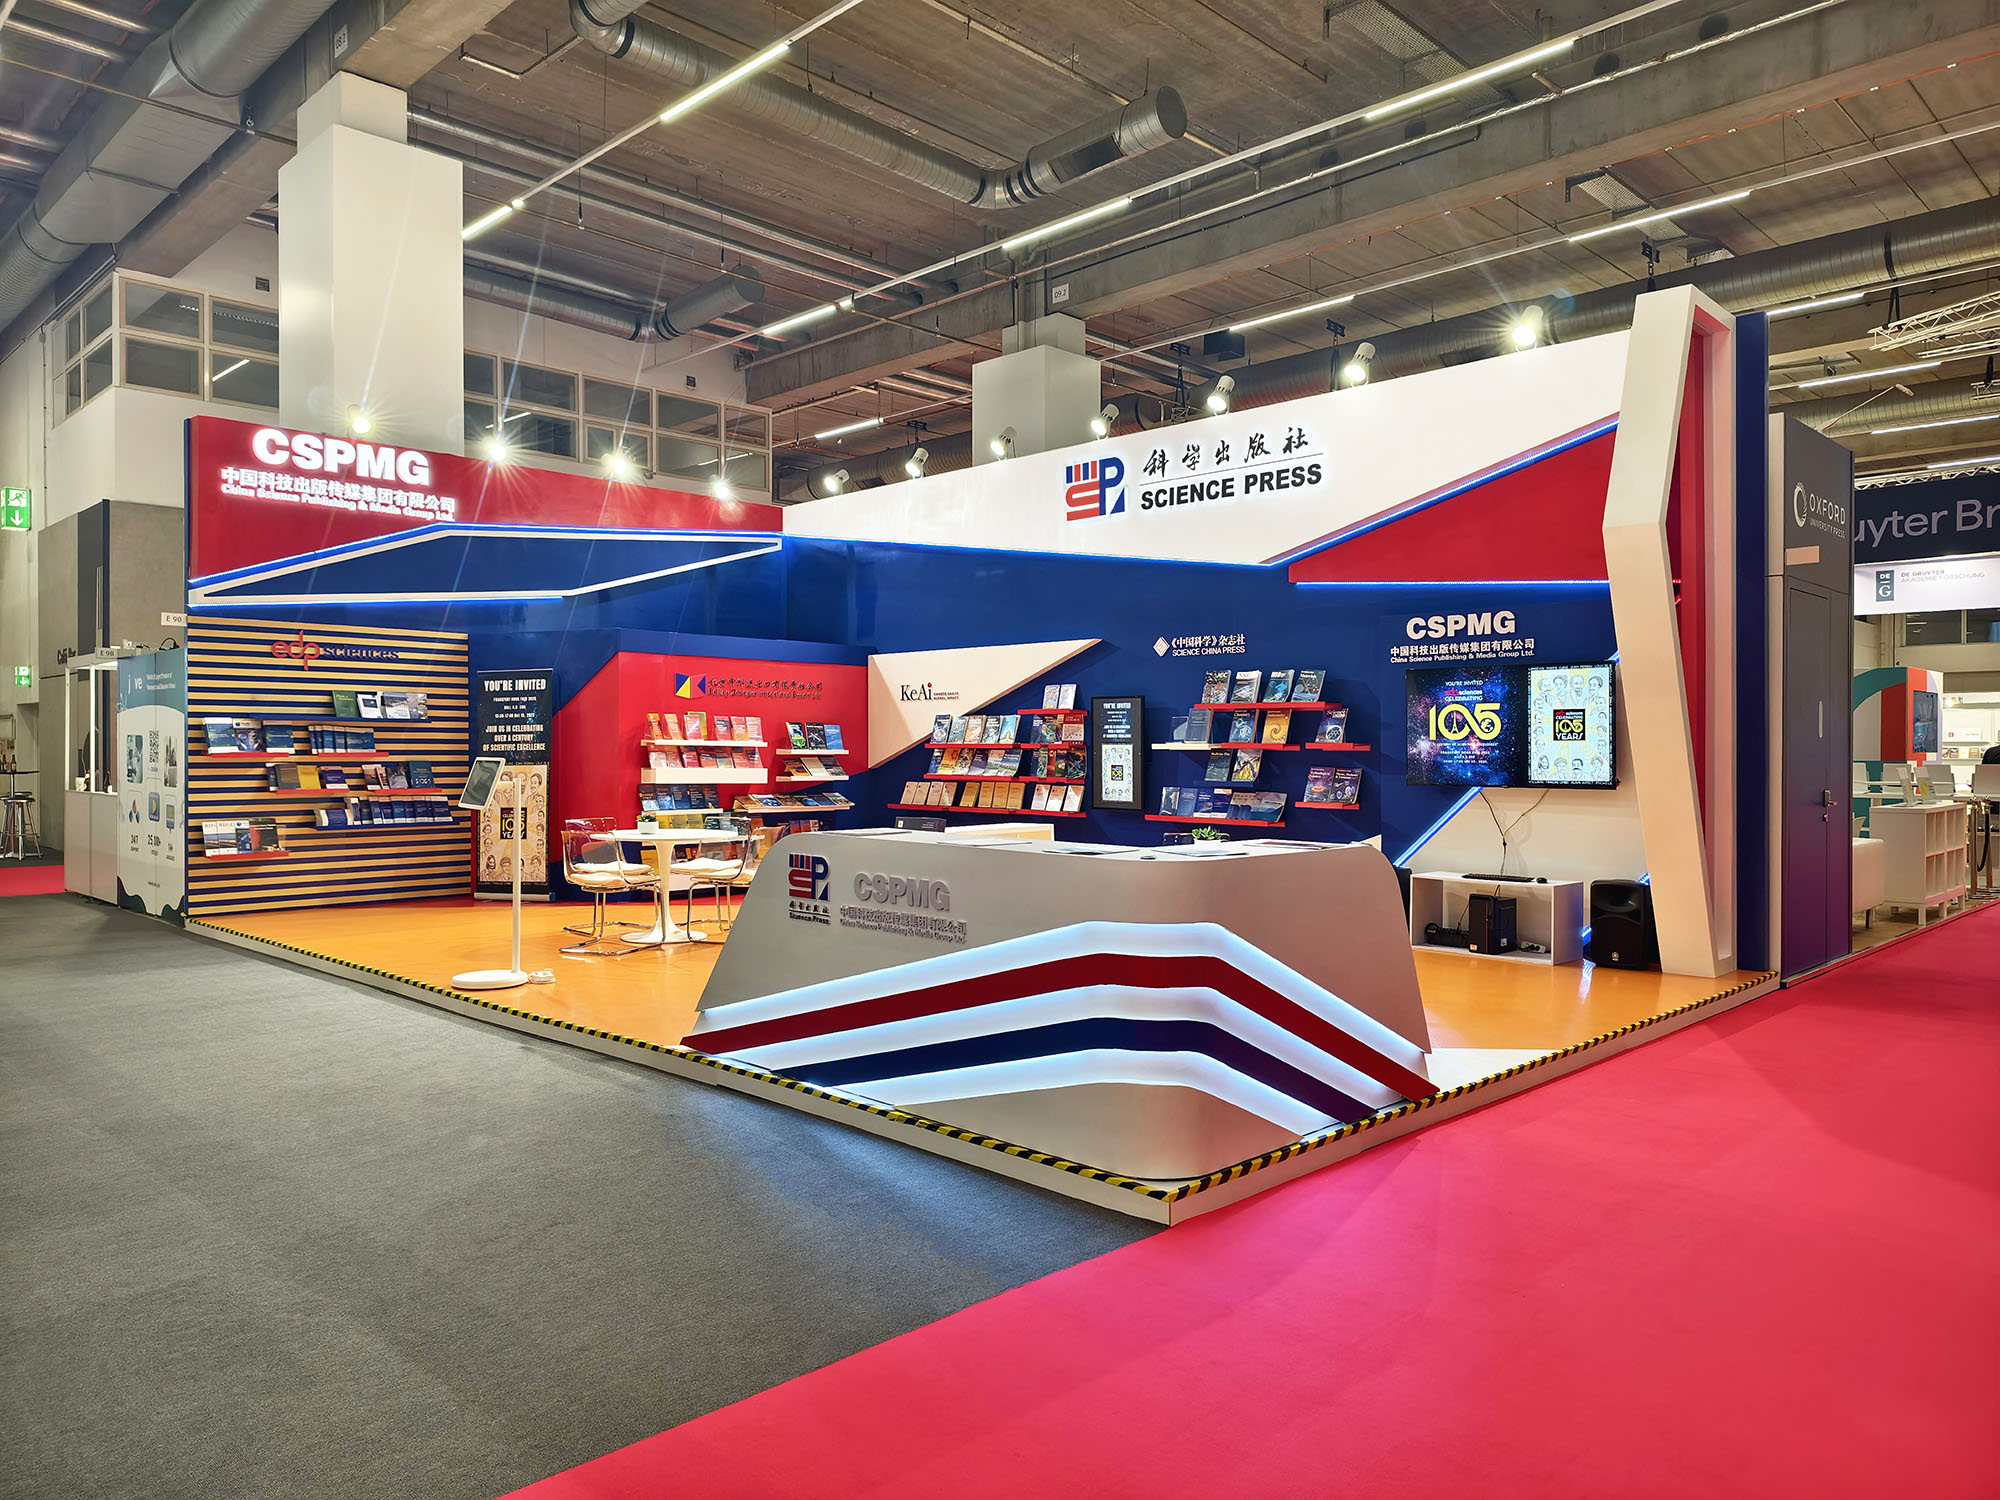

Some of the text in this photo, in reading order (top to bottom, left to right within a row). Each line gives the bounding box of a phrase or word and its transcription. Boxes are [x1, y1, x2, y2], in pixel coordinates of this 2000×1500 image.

[1054, 289, 1067, 298] 09.2
[252, 428, 431, 486] CSPMG
[1143, 426, 1308, 478] 科学出版社
[221, 467, 456, 513] 中国科技出版传媒集团有限公司
[1141, 463, 1322, 510] SCIENCE PRESS
[221, 483, 255, 497] China
[257, 487, 300, 503] Science
[301, 493, 356, 511] Publishing
[358, 501, 368, 511] &
[370, 502, 401, 515] Media
[403, 507, 434, 521] Group
[1810, 493, 1846, 525] OXFORD
[1879, 584, 1893, 598] G
[1406, 610, 1516, 640] CSPMG
[271, 629, 401, 671] edp sciences
[1172, 645, 1246, 656] SCIENCE CHINA PRESS
[1390, 638, 1535, 657] 中国科技出版传媒集团有限公司
[1409, 654, 1432, 663] Science
[1434, 653, 1467, 661] Publishing
[1468, 652, 1475, 660] &
[1476, 651, 1496, 659] Media
[1498, 650, 1520, 659] Group
[1521, 649, 1535, 657] Ltd.
[484, 679, 546, 691] YOU'RE INVITED
[900, 682, 933, 701] KeAi
[1429, 703, 1502, 740] 105
[1556, 719, 1583, 733] 105
[490, 743, 516, 751] SCIENTIFIC
[517, 742, 546, 751] EXCELLENCE
[854, 872, 950, 912] CSPMG
[789, 912, 812, 922] Science
